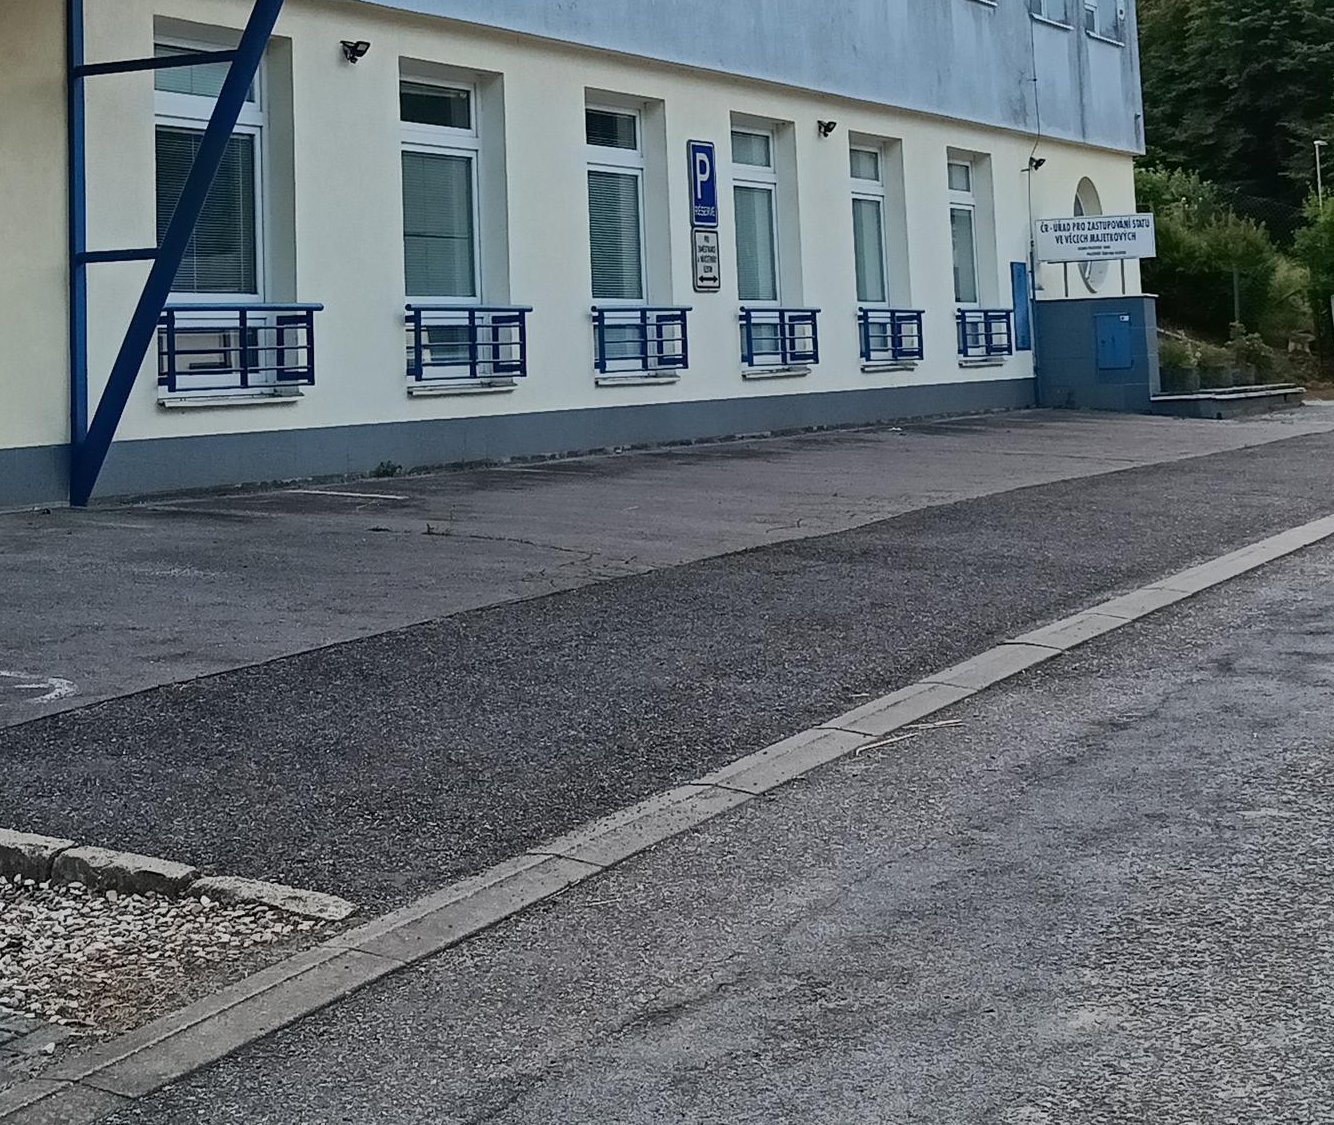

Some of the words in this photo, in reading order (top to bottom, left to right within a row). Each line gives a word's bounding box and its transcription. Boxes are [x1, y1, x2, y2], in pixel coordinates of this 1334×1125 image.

[695, 152, 710, 199] P
[1072, 222, 1086, 231] PRO
[1087, 217, 1131, 231] ZASTUPOVÁNÍ
[1055, 235, 1064, 245] VE
[1089, 230, 1137, 243] MAJETKOVÝCH
